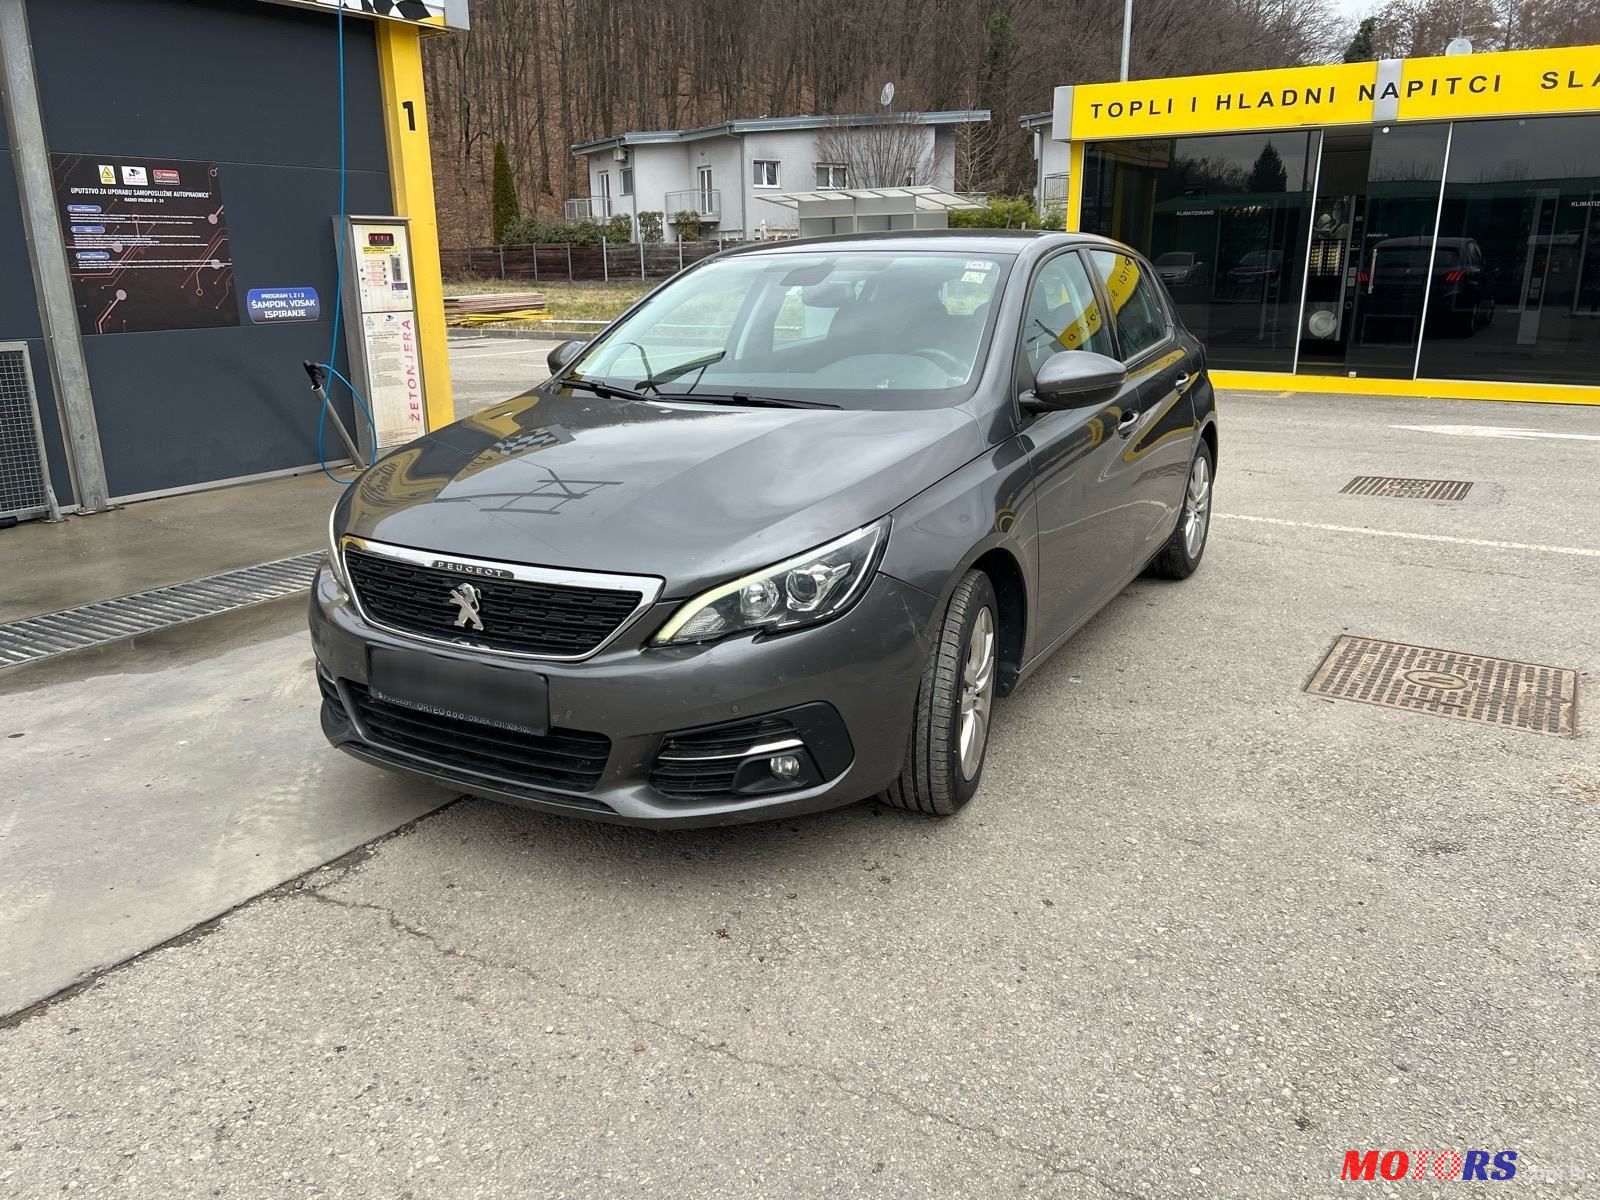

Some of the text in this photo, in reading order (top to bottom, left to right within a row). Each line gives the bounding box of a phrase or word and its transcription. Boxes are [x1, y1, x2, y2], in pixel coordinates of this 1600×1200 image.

[1090, 98, 1173, 119] TOPLI
[1191, 96, 1197, 113] I
[1216, 86, 1336, 111] HLADNI
[1358, 74, 1501, 102] NAPITCI
[402, 100, 416, 131] 1
[70, 187, 99, 195] UPUTSTVO
[251, 299, 316, 309] ŠAMPON, VOSAK
[264, 309, 307, 318] ISPIRANJE
[401, 319, 420, 422] ŽETONJERA
[437, 561, 504, 577] PEUGEOT
[417, 702, 445, 715] ORTEO
